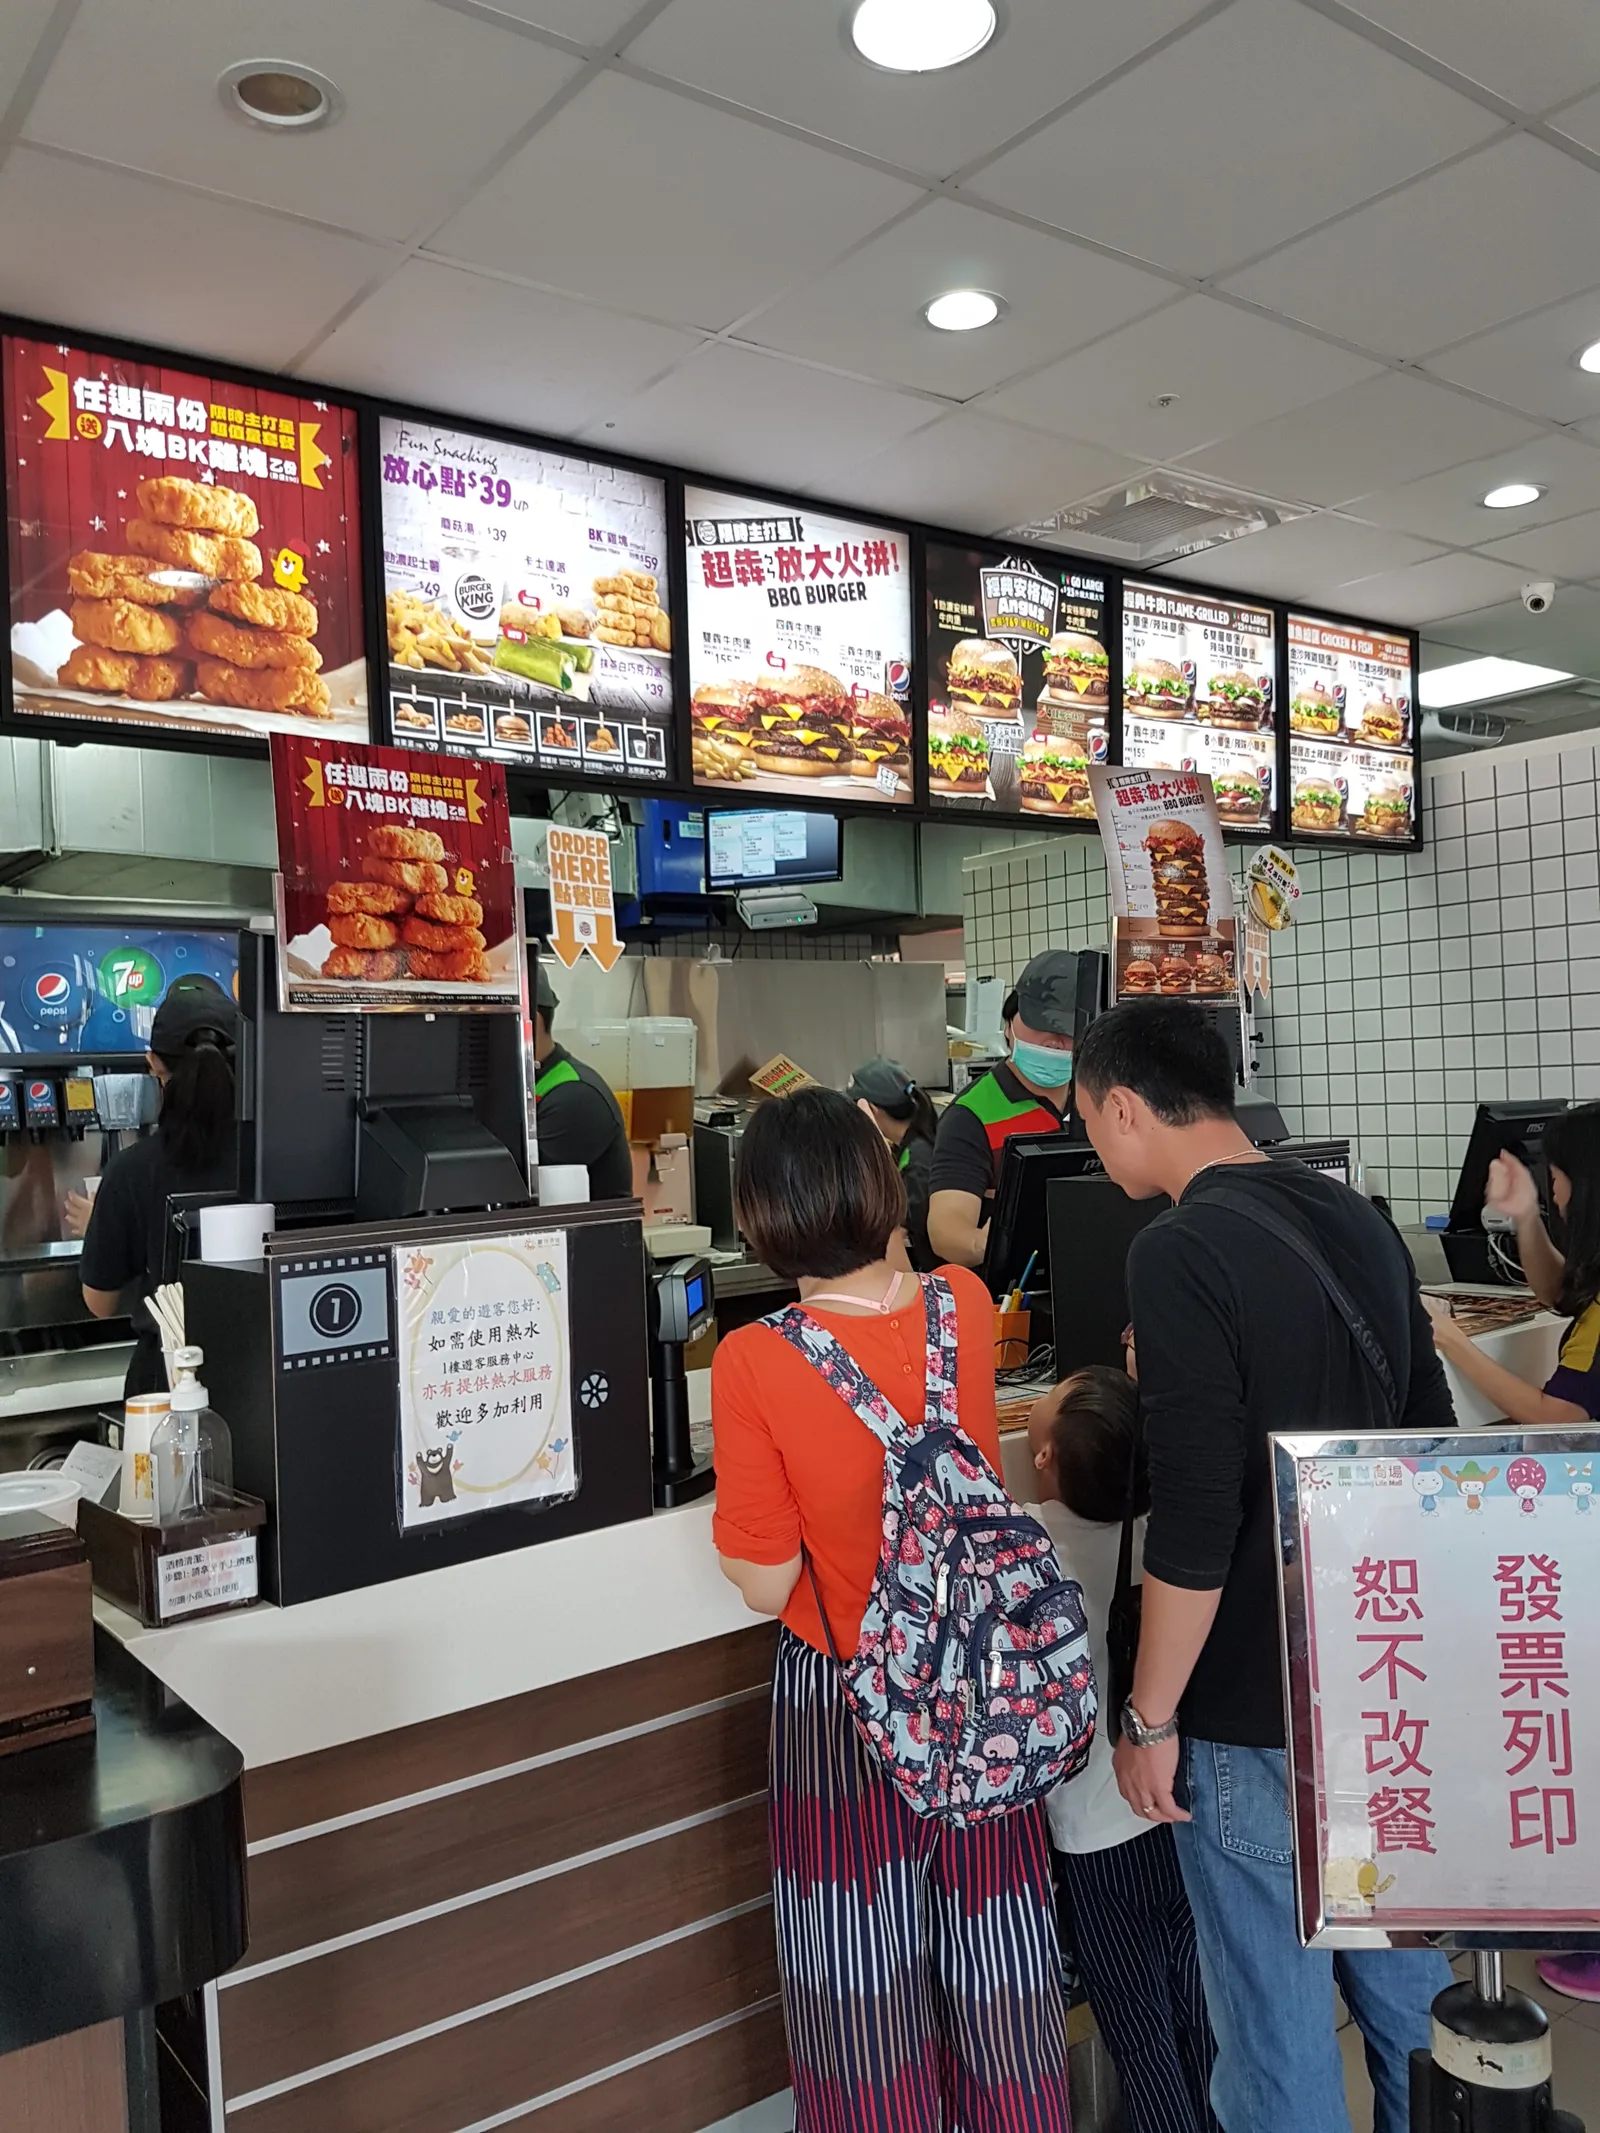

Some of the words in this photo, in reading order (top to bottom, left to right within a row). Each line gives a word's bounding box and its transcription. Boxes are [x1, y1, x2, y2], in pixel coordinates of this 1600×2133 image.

[73, 377, 208, 432] 任選兩份
[103, 419, 268, 478] 八塊BK雞塊
[399, 430, 429, 451] Fun
[434, 438, 498, 475] Snacking
[459, 583, 492, 596] BURGER
[767, 586, 802, 607] BBQ
[805, 581, 867, 604] BURGER
[985, 575, 1054, 611] 經典安格斯
[1071, 576, 1081, 589] GO
[1082, 578, 1105, 593] LARGE
[461, 592, 494, 608] KING
[998, 597, 1045, 623] Angus
[1123, 590, 1167, 614] 經典牛肉
[1168, 601, 1230, 625] FLAME-GRILLED
[1123, 614, 1130, 626] 5
[1203, 628, 1209, 640] 6
[1124, 724, 1130, 737] 7
[1205, 734, 1210, 746] 8
[324, 762, 409, 793] 任選兩份
[345, 789, 448, 821] 八塊BK雞塊
[1162, 798, 1179, 811] BBQ
[1179, 794, 1206, 808] BURGER
[549, 830, 608, 858] ORDER
[551, 851, 611, 886] HERE
[40, 1006, 68, 1017] pepsi
[330, 1297, 341, 1325] 1
[431, 1299, 540, 1326] 親愛的遊客您好:
[428, 1321, 540, 1352] 如需使用熱水
[443, 1350, 534, 1375] 1樓遊客服務中心
[422, 1364, 553, 1401] 亦有提供熱水服務
[435, 1393, 542, 1430] 歡迎多加利用
[1352, 1555, 1437, 1855] 恕不改餐
[1493, 1553, 1577, 1855] 發票列印
